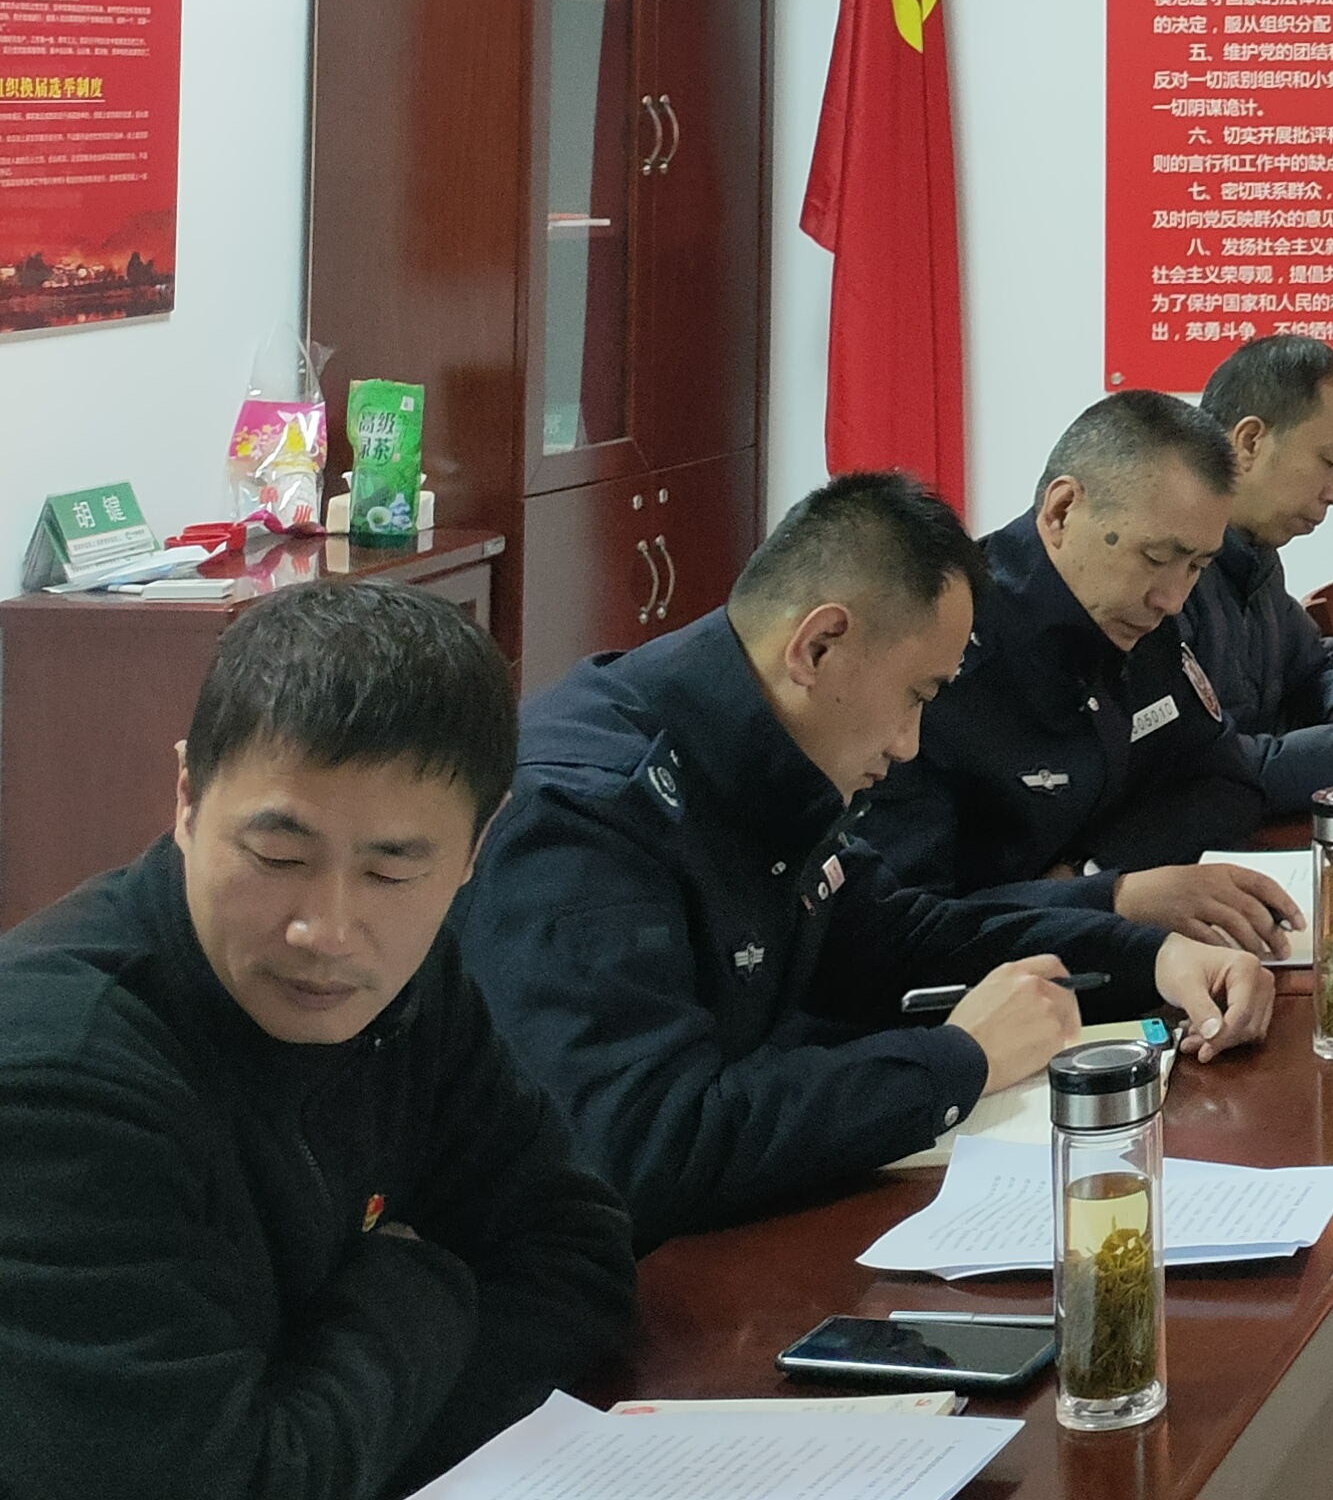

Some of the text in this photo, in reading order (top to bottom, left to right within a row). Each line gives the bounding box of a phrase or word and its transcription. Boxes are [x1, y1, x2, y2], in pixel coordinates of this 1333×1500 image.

[0, 77, 103, 98] 织换届选举制度
[1154, 99, 1263, 116] 一切阴谋诡计。
